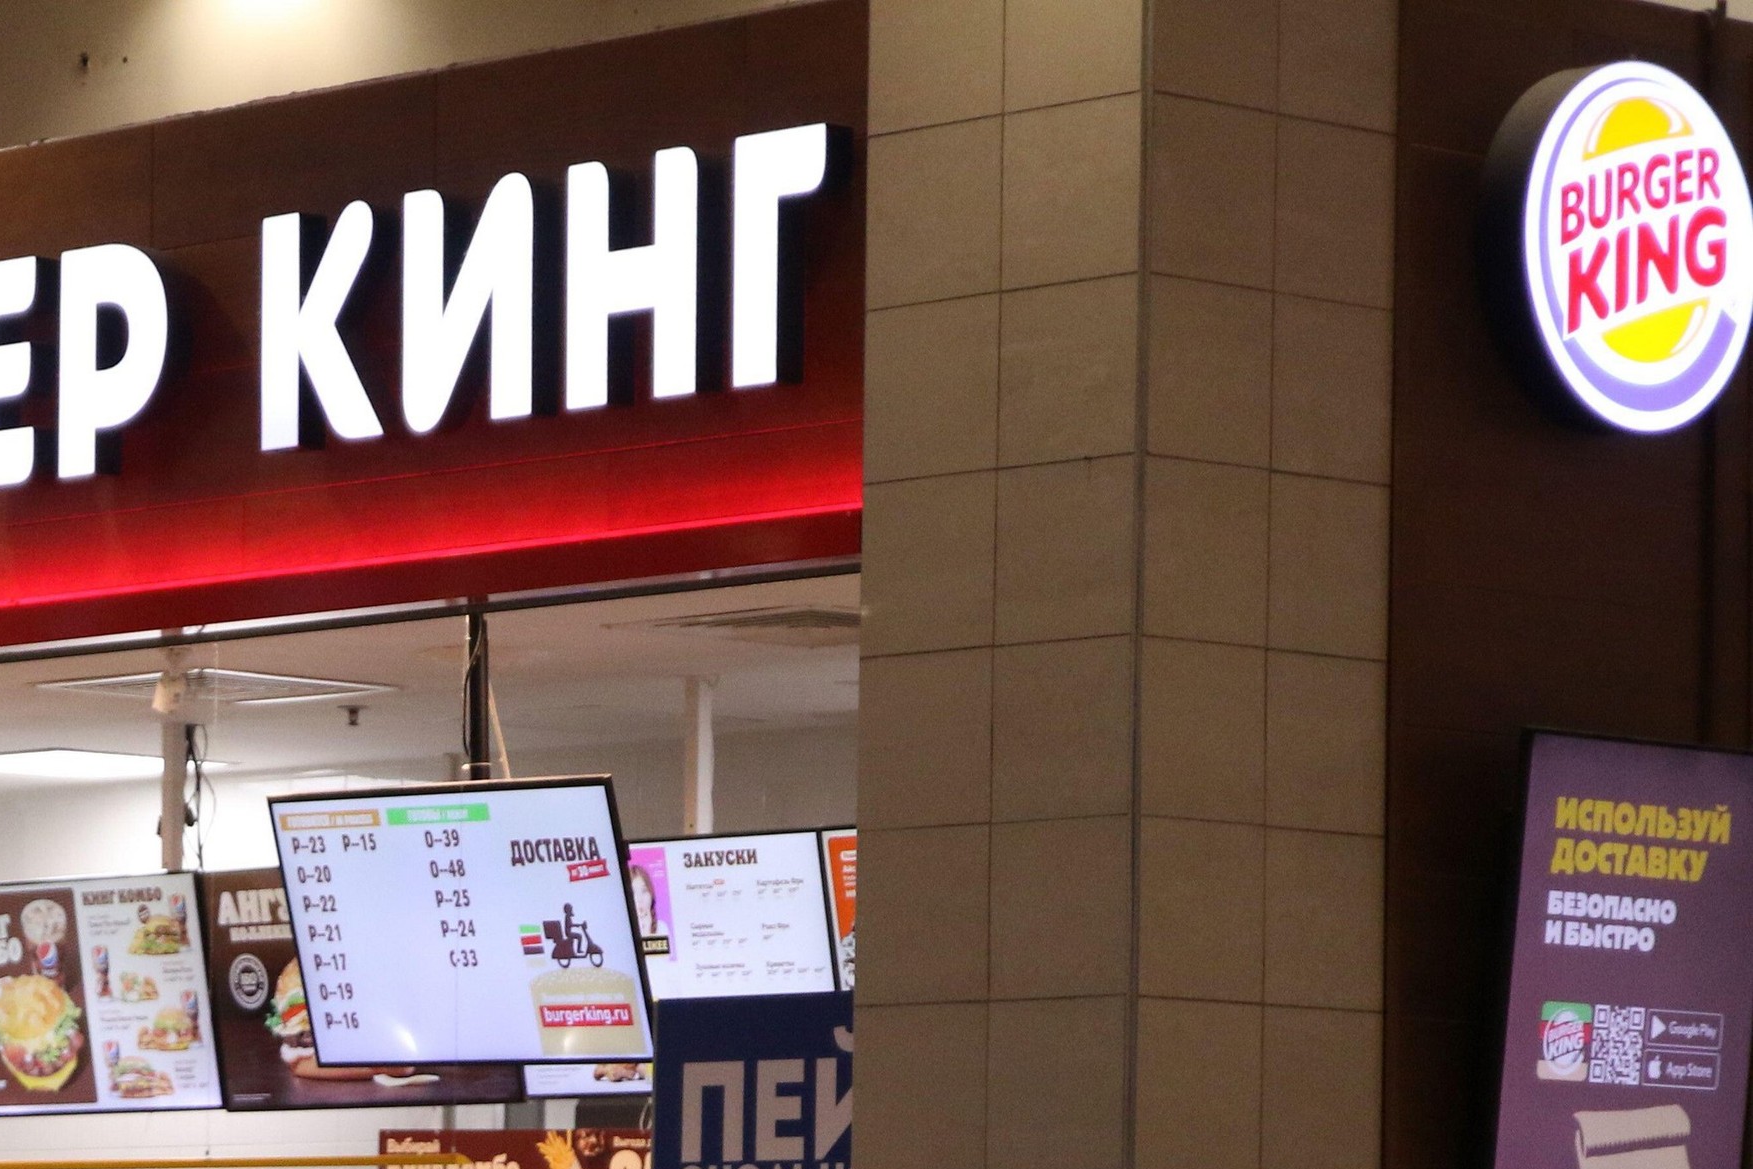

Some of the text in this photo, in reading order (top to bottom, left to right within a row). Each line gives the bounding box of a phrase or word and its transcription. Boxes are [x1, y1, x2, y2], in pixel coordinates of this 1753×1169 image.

[1560, 147, 1721, 246] BURGER
[1566, 205, 1727, 335] KING
[260, 122, 827, 452] КИНГ
[1555, 796, 1732, 845] ИСПОЛЬЗУЙ
[510, 836, 601, 867] ДОСТАВКА
[683, 848, 758, 868] ЗАКУСКИ
[1550, 838, 1709, 882] ДОСТАВКУ
[1547, 890, 1677, 925] БЕЗОПАСНО
[1544, 919, 1655, 952] И БЫСТРО
[543, 1004, 630, 1026] burgerking.ru
[1668, 1020, 1699, 1039] Google
[1548, 1031, 1585, 1058] KING
[1665, 1061, 1713, 1078] App Store
